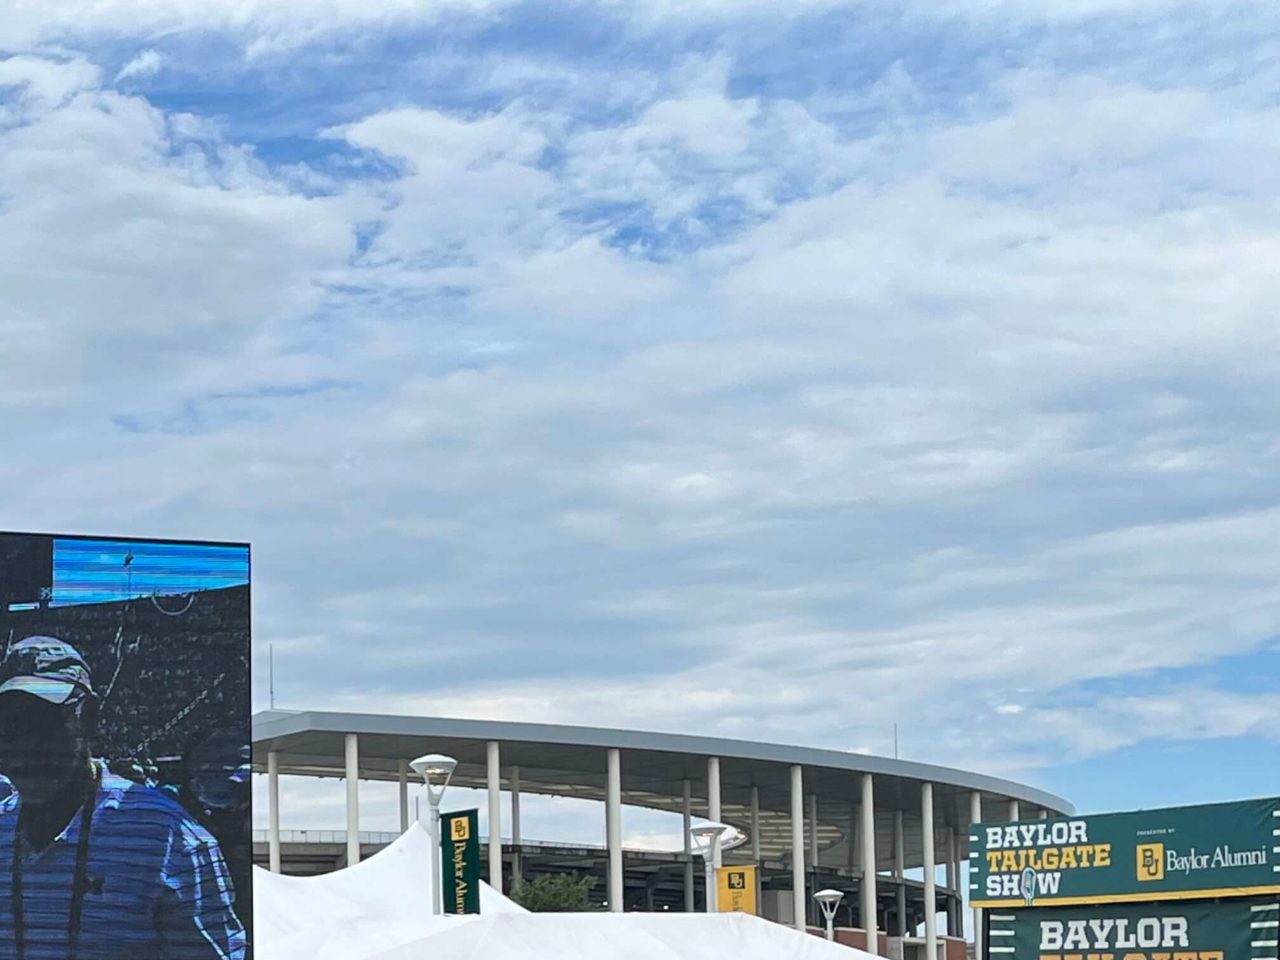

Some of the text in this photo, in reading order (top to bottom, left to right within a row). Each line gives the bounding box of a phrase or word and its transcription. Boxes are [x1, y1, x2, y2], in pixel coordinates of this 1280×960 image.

[986, 821, 1088, 848] BAYLOR
[452, 842, 467, 878] Baylor
[986, 844, 1111, 872] TAILGATE
[1166, 845, 1268, 875] Baylor Alumni
[1040, 917, 1189, 950] BAYLOR
